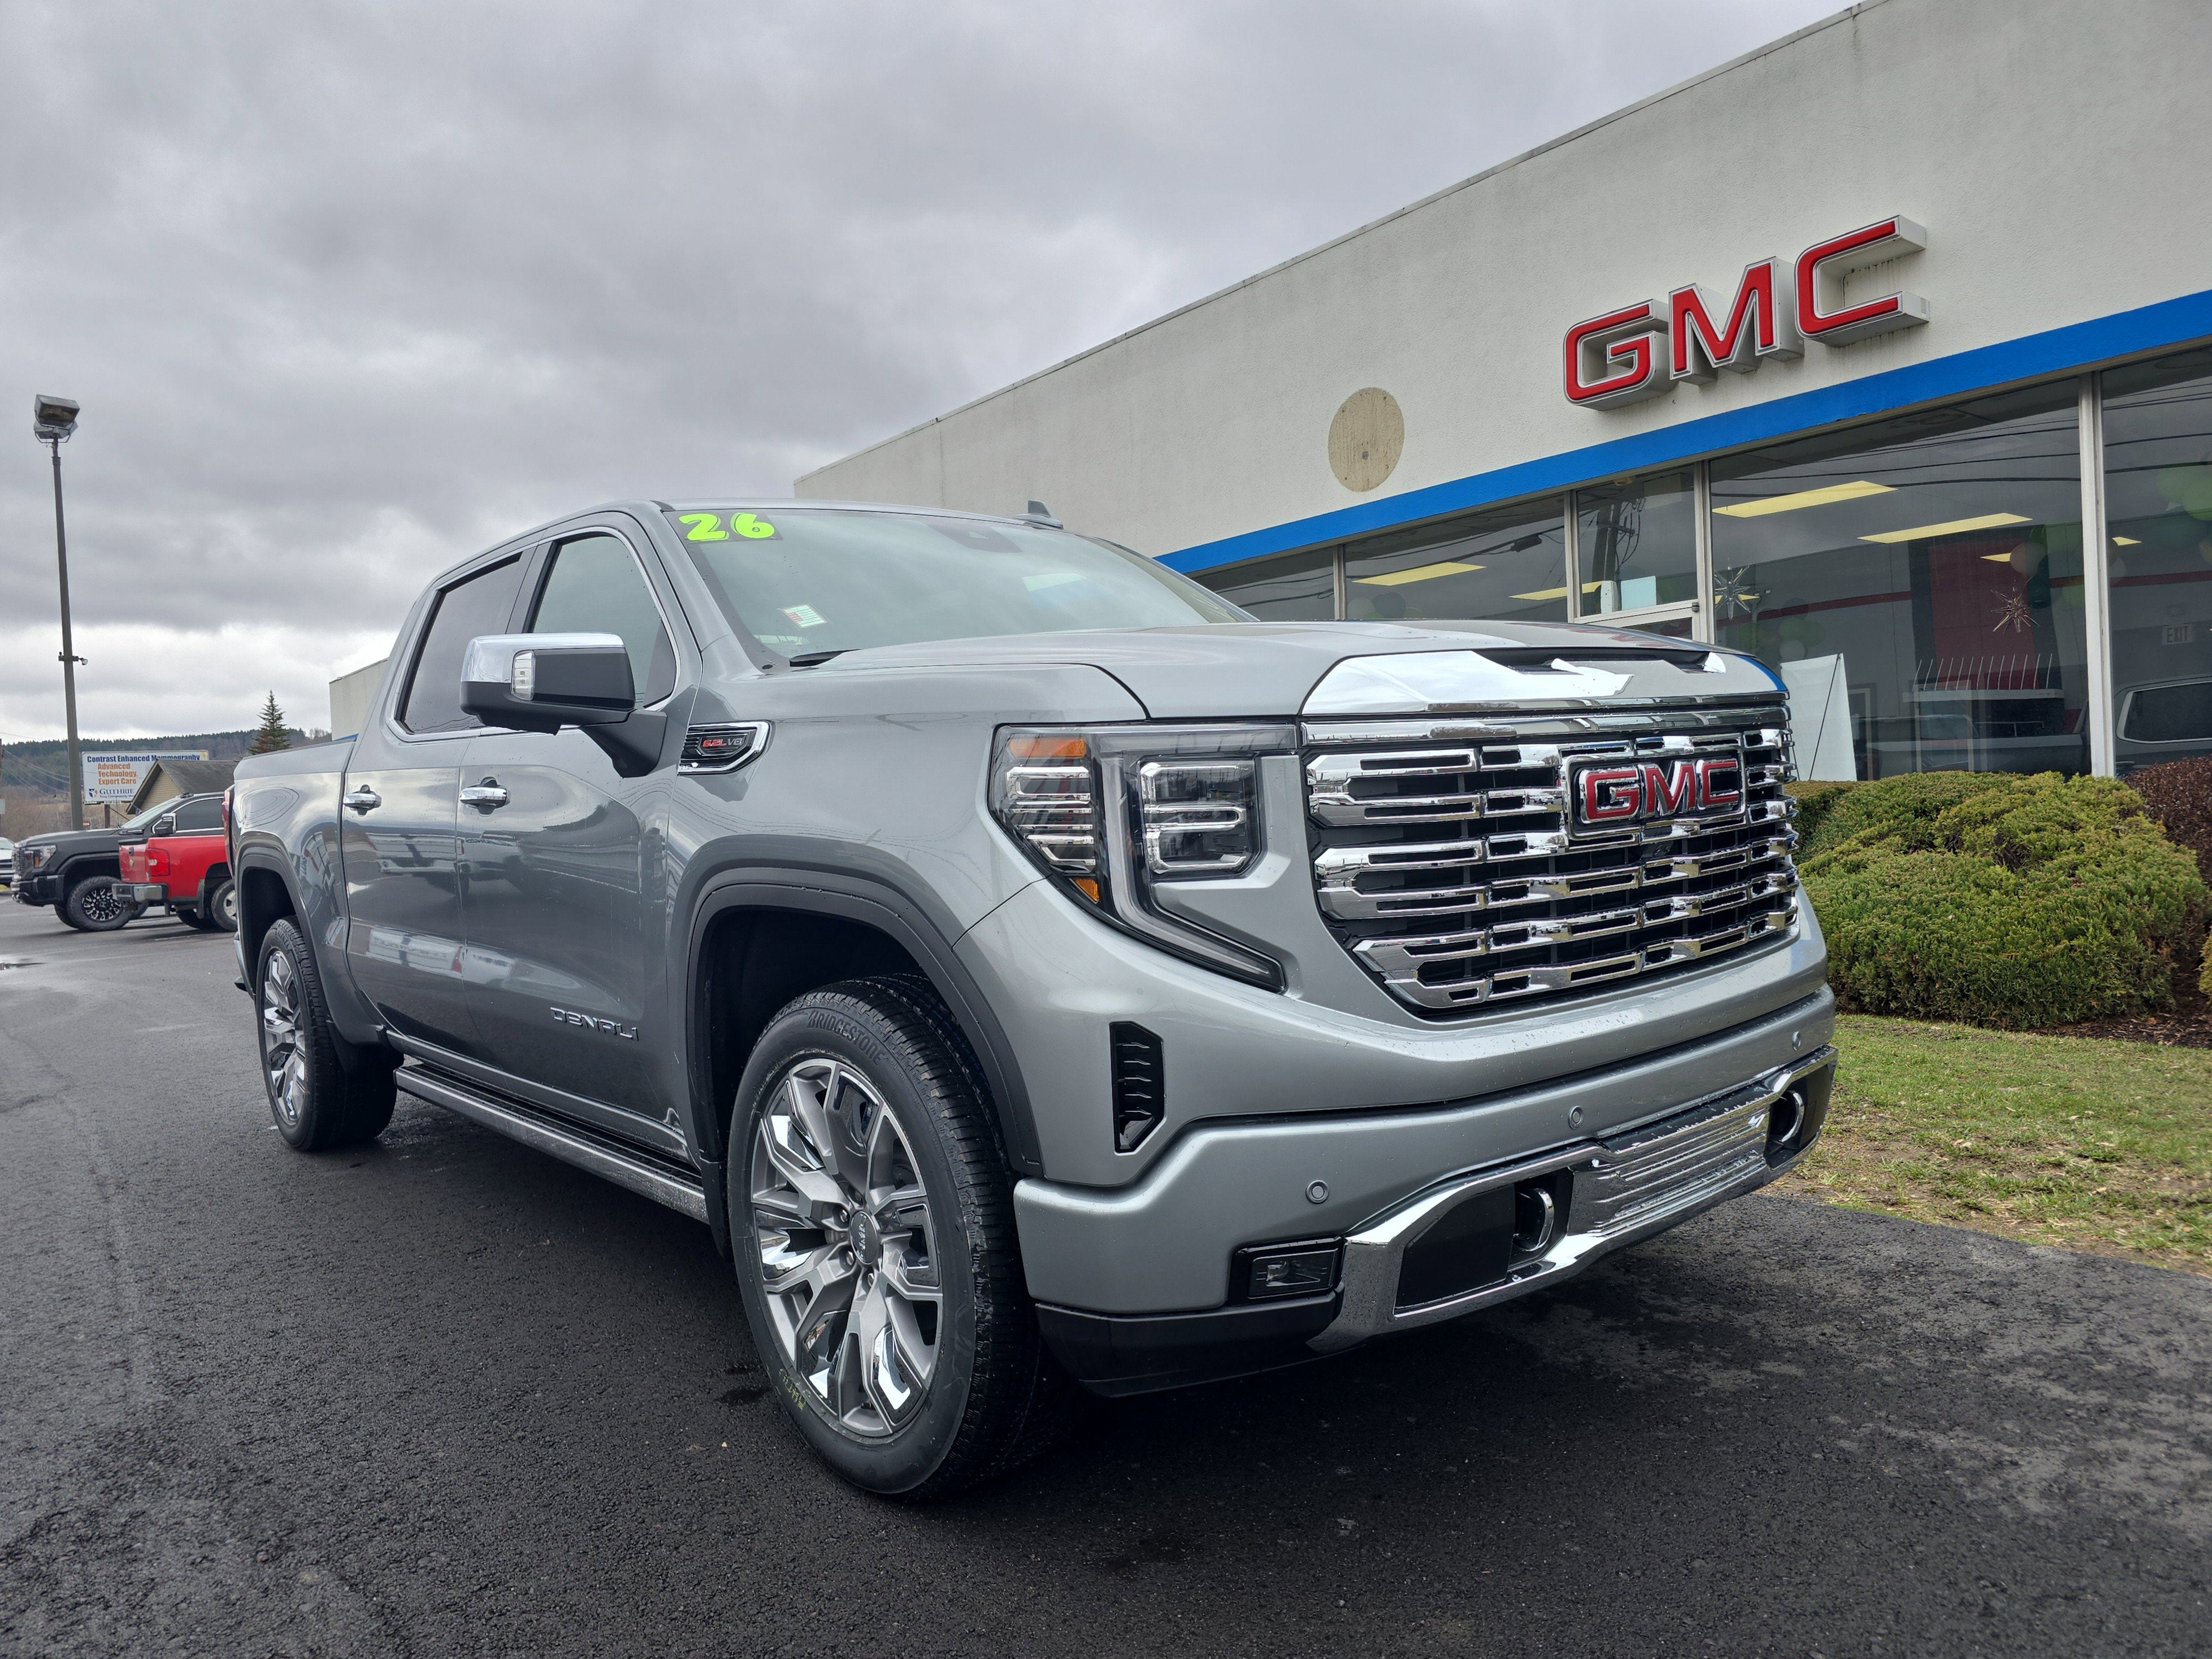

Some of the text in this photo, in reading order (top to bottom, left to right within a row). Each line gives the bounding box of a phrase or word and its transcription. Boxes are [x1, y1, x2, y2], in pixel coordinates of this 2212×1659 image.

[1563, 214, 1914, 407] GMC
[679, 512, 775, 541] 26
[2167, 626, 2188, 643] EXIT
[728, 737, 743, 745] V8
[1580, 758, 1739, 824] GMC
[550, 1007, 639, 1041] DENALI
[807, 1009, 887, 1066] BRIDGESTONE
